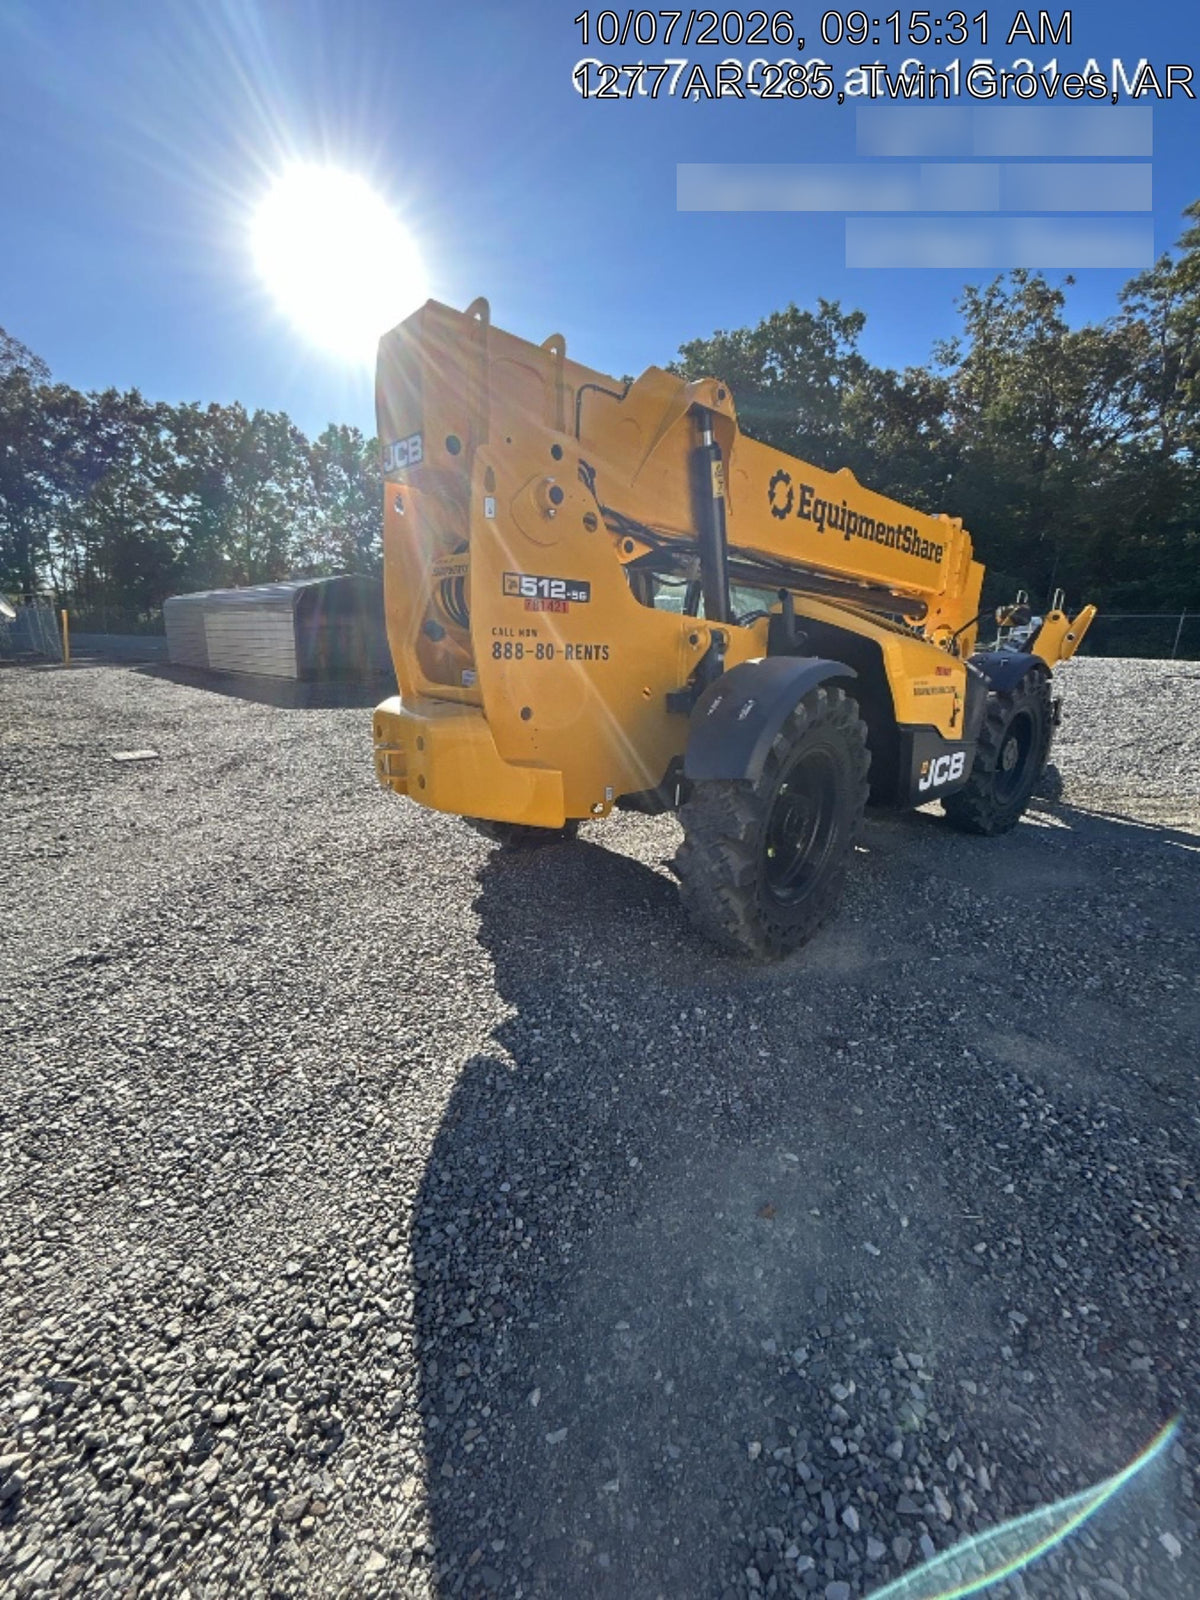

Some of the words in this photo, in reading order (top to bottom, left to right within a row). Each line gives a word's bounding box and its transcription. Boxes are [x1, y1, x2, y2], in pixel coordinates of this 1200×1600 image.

[384, 434, 422, 472] JCB
[797, 483, 943, 564] EquipmentShare
[491, 626, 515, 638] CALL
[491, 641, 609, 660] 888-80-RENTS
[918, 751, 966, 792] JCB
